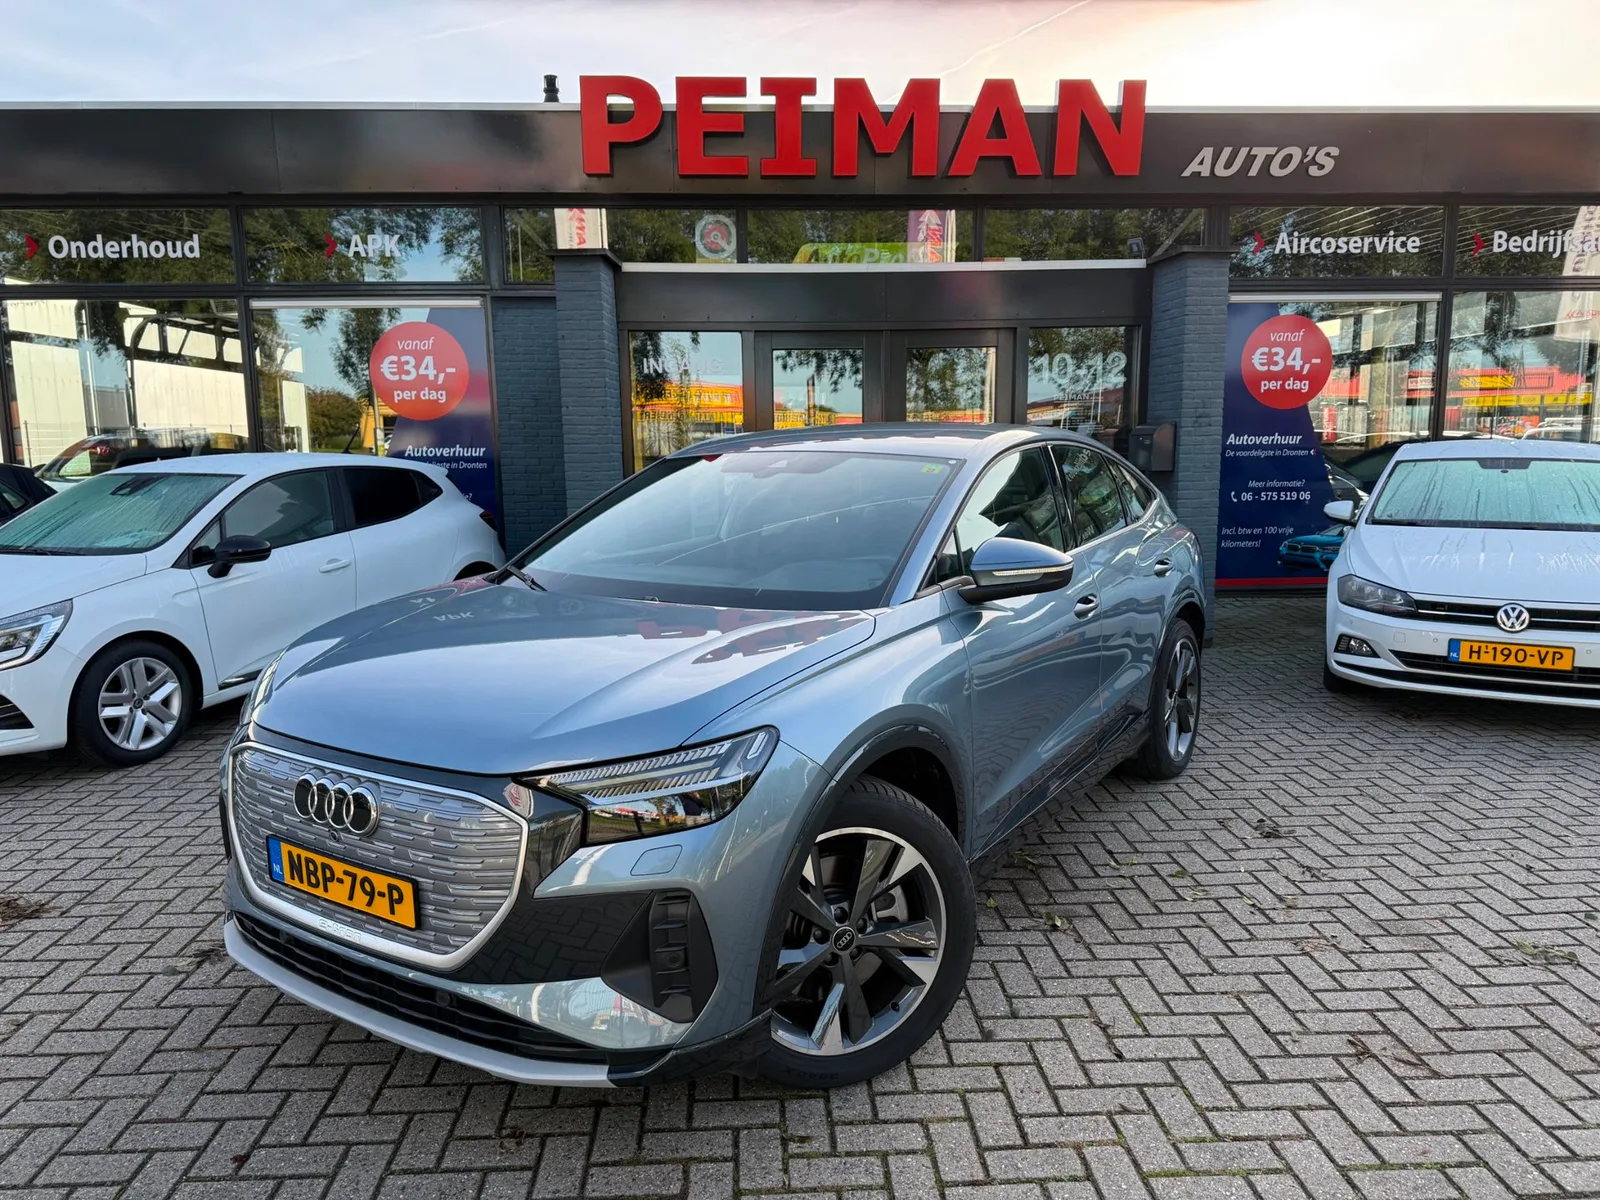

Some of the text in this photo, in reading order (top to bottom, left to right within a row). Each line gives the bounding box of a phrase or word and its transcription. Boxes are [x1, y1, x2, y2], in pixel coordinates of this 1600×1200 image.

[580, 75, 1147, 178] PEIMAN
[1180, 146, 1340, 177] AUTO'S
[48, 234, 200, 259] Onderhoud
[348, 234, 400, 257] APK
[1274, 230, 1421, 254] Aircoservice
[1493, 230, 1600, 258] Bedrijfsa
[1270, 328, 1305, 342] vanaf
[397, 337, 435, 350] vanaf
[1252, 347, 1321, 375] €34,-
[380, 355, 456, 385] €34,-
[1261, 377, 1309, 393] per dag
[393, 387, 446, 404] per dag
[1226, 432, 1302, 445] Autoverhuur
[404, 444, 486, 457] Autoverhuur
[1225, 449, 1235, 457] De
[1235, 449, 1275, 458] voordeligste
[1275, 449, 1282, 457] in
[451, 461, 458, 469] in
[458, 461, 488, 469] Dronten
[1266, 479, 1306, 488] informatie?
[1241, 492, 1253, 501] 06
[1260, 492, 1278, 501] 575
[1280, 491, 1297, 500] 519
[1299, 491, 1311, 500] 06
[1221, 527, 1237, 535] Incl.
[1264, 526, 1278, 534] 100
[1278, 526, 1294, 536] vrije
[1221, 540, 1262, 548] kilometers!
[1468, 645, 1564, 666] H-190-VP
[273, 850, 404, 916] NL NBP-79-P
